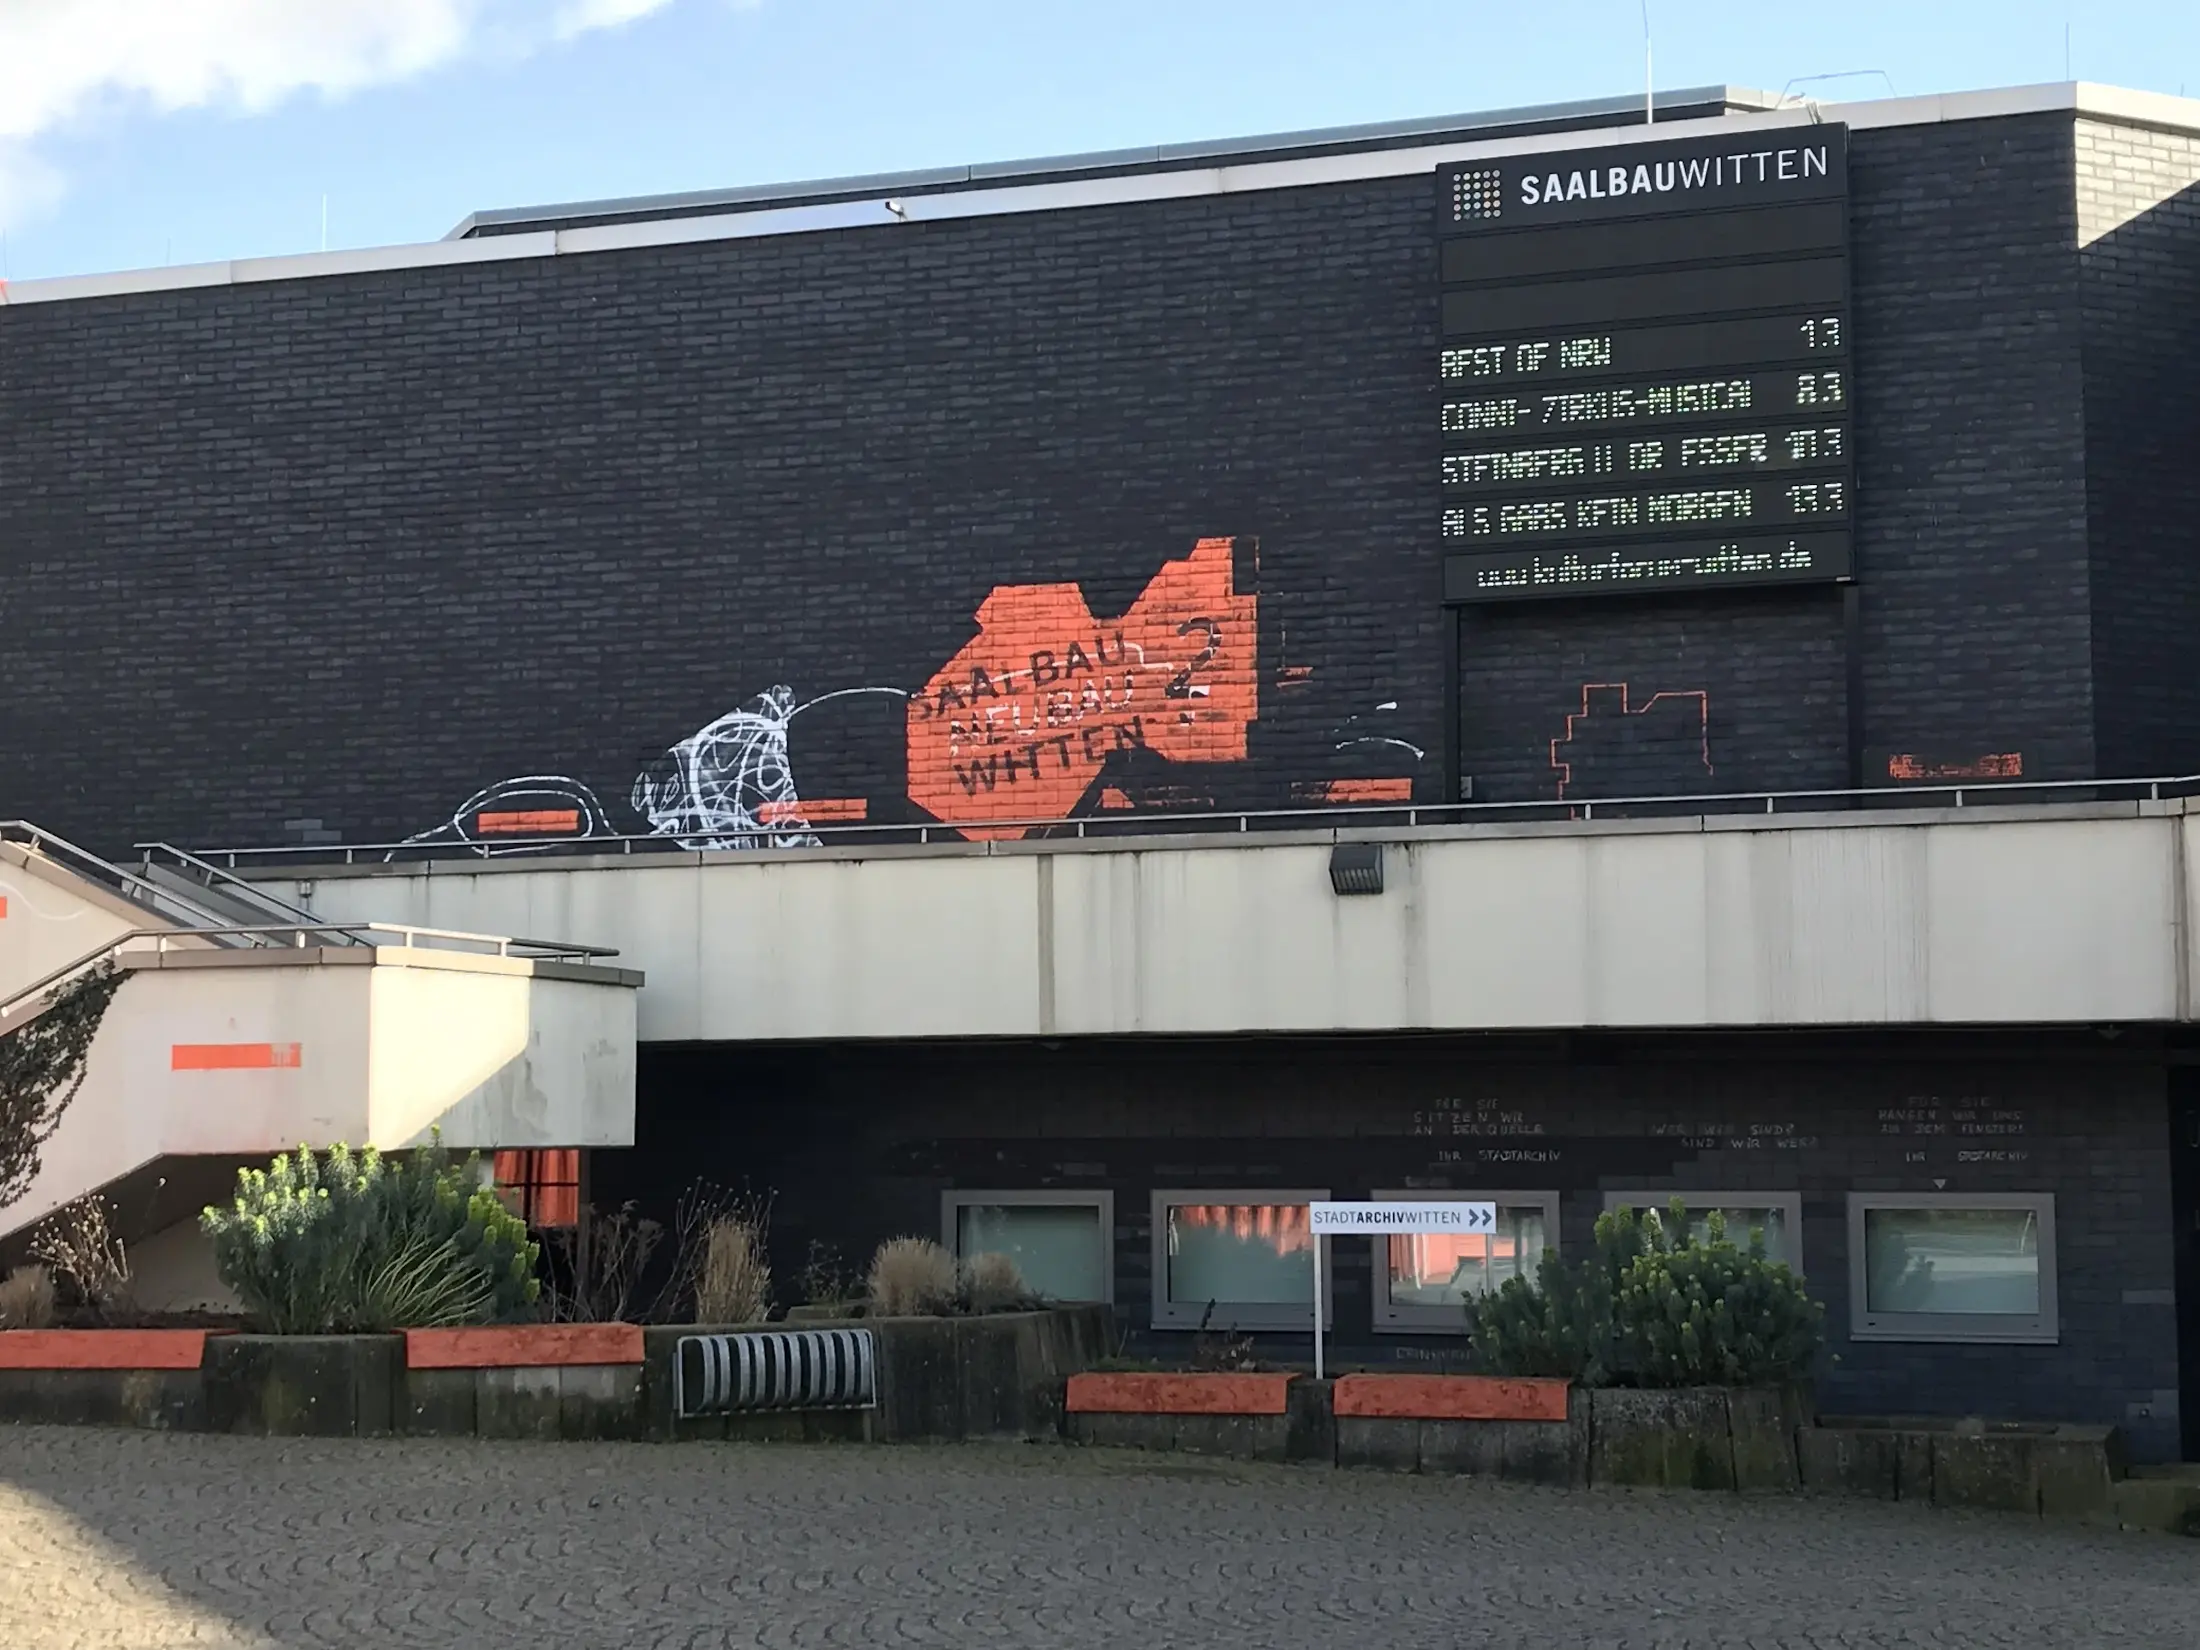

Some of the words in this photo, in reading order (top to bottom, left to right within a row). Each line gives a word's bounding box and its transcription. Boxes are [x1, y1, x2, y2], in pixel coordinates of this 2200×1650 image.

[1521, 146, 1827, 204] SAALBAUWITTEN
[909, 631, 1125, 720] SAALBAU
[950, 668, 1134, 757] NEUBAU
[953, 715, 1147, 796] WITTEN
[1314, 1211, 1461, 1225] STADTARCHIVWITTEN
